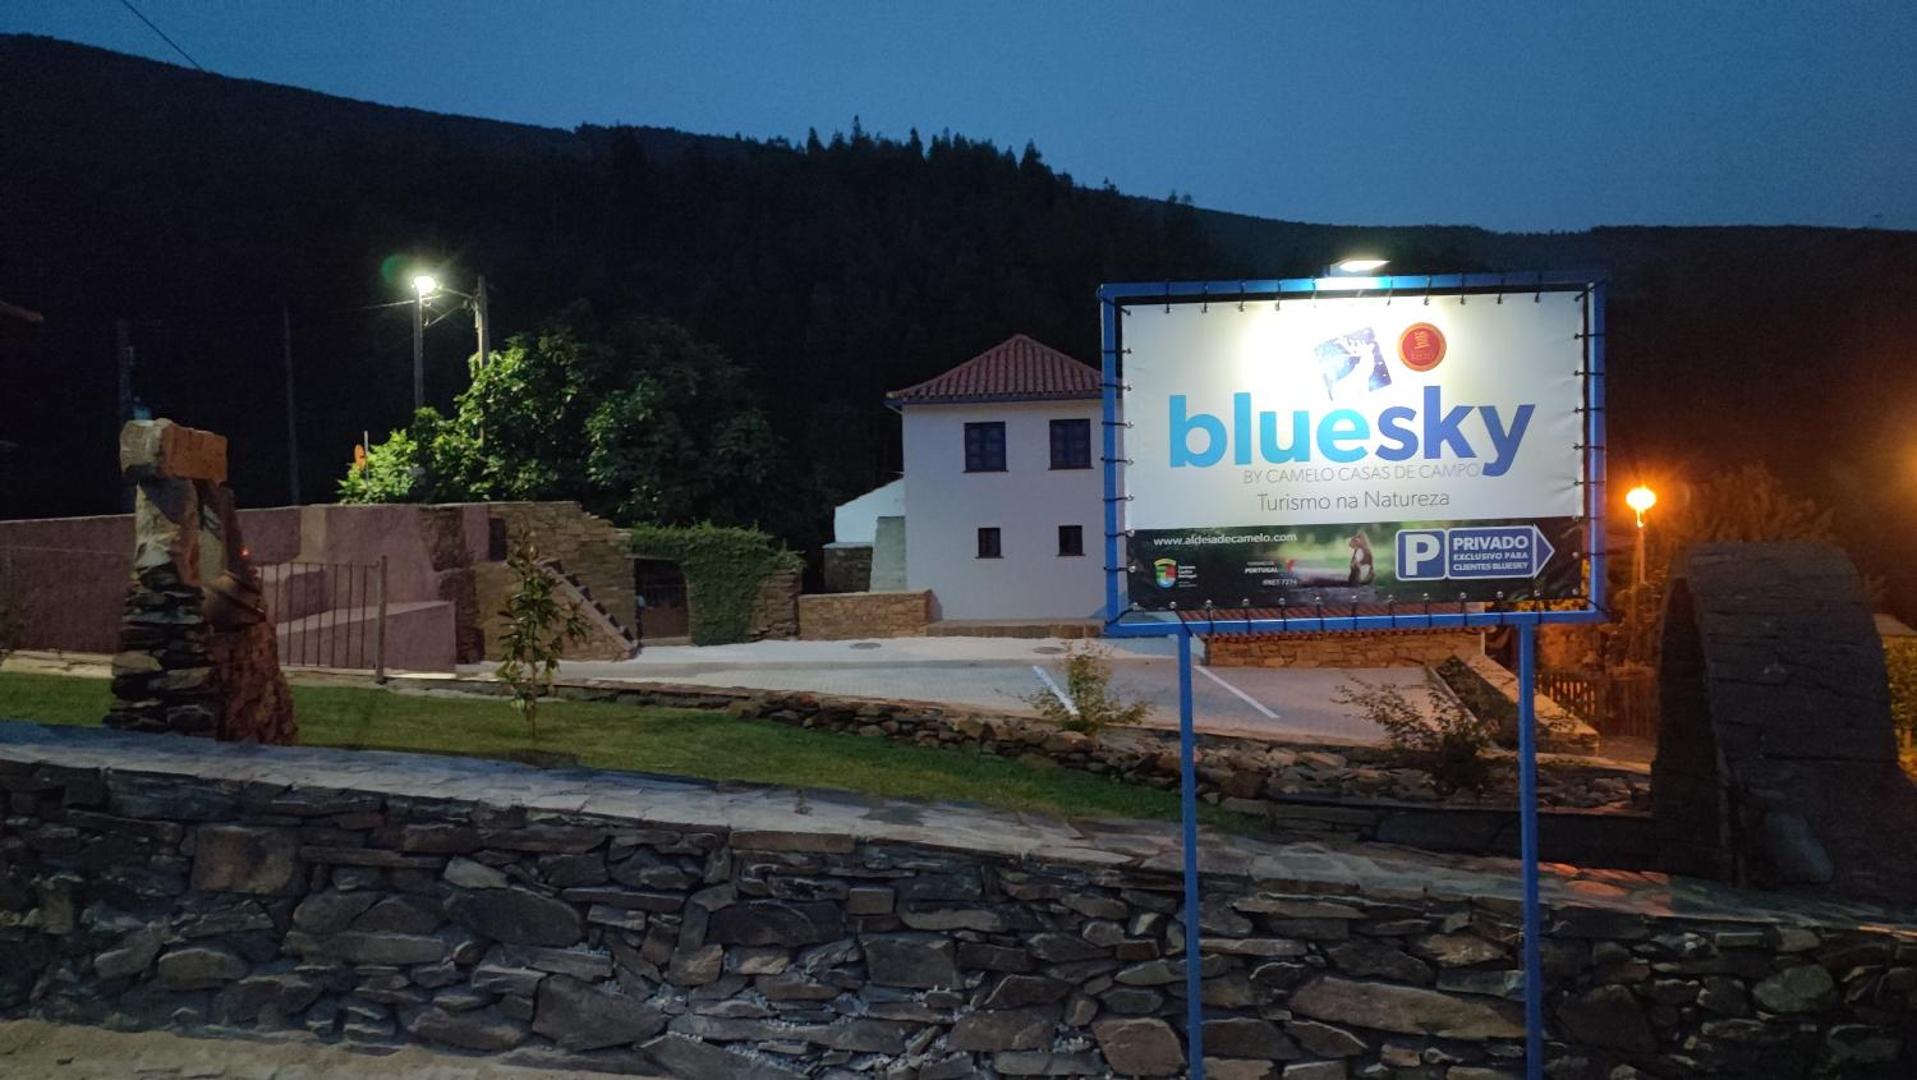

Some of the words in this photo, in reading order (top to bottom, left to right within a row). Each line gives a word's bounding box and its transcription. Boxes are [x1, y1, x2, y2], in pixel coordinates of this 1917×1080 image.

[1169, 385, 1536, 477] bluesky
[1244, 468, 1262, 484] BY
[1266, 466, 1335, 484] CAMELO
[1338, 465, 1391, 481] CASAS
[1395, 464, 1417, 479] DE
[1419, 463, 1479, 479] CAMPO
[1257, 493, 1331, 512] Turismo
[1337, 496, 1358, 510] na
[1364, 489, 1450, 508] Natureza
[1153, 533, 1297, 546] www.aldeiadecamelo.com
[1453, 535, 1529, 550] PRIVADO
[1405, 534, 1440, 576] P
[1453, 552, 1502, 561] EXCLUSIVO
[1504, 551, 1529, 559] PARA
[1453, 563, 1491, 571] CLIENTES
[1492, 562, 1529, 570] BLUESKY
